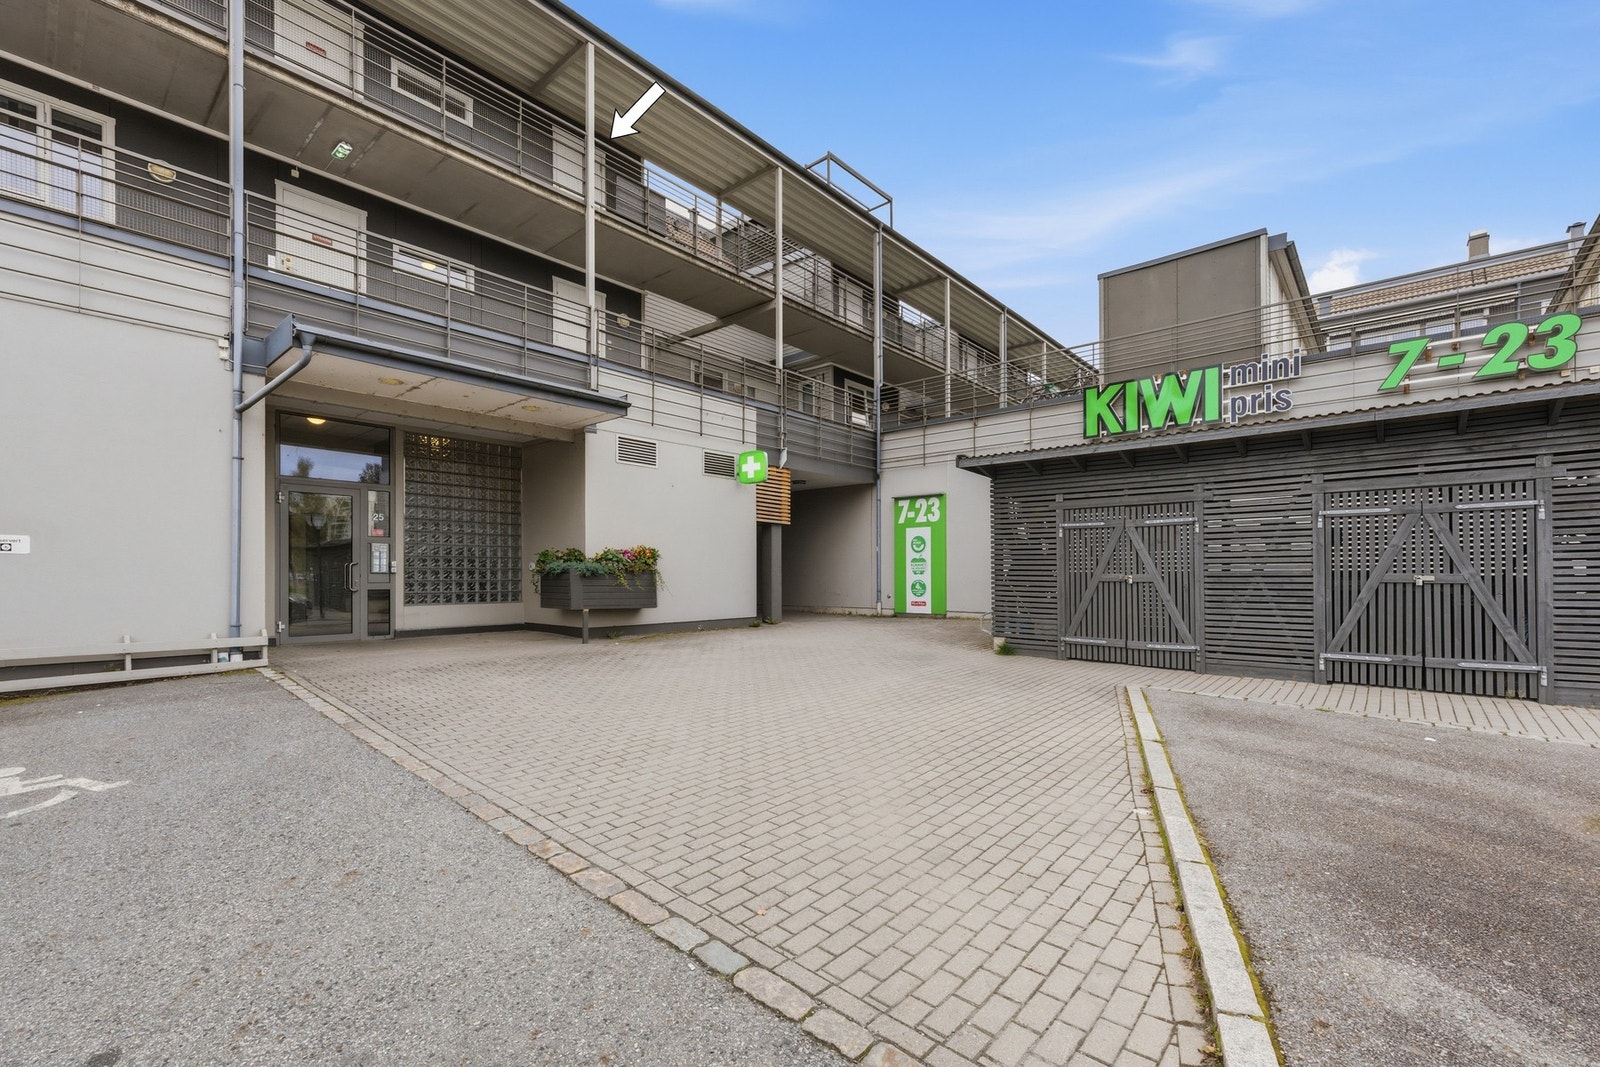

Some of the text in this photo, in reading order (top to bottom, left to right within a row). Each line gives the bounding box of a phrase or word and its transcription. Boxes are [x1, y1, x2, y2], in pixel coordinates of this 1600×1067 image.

[1083, 349, 1302, 439] KIWI mini
[1230, 384, 1293, 423] pris
[372, 513, 384, 521] 25
[898, 498, 940, 524] 7-23
